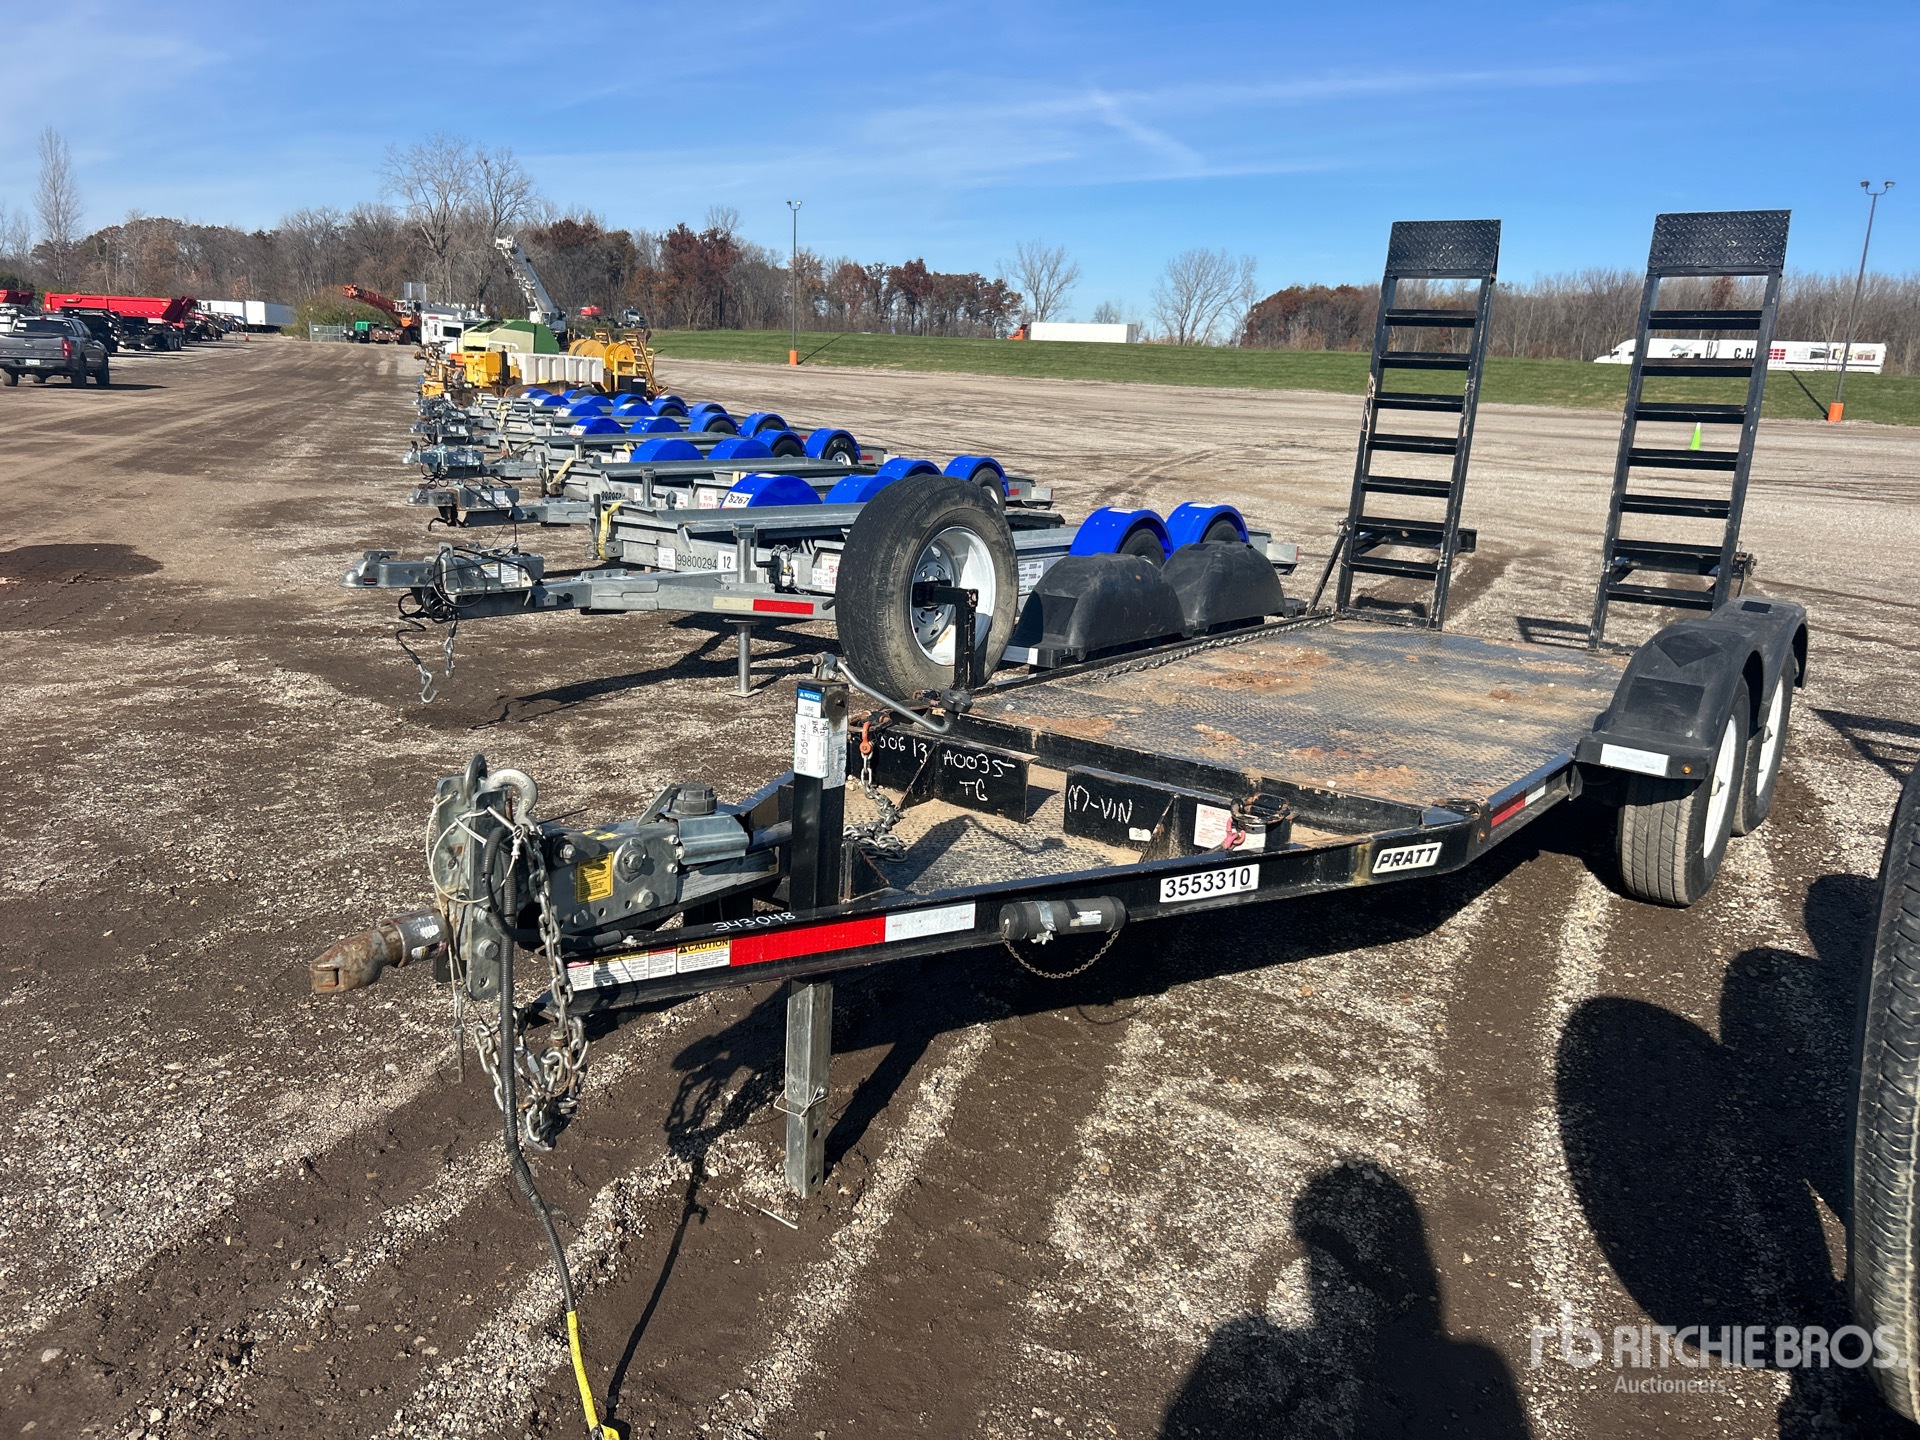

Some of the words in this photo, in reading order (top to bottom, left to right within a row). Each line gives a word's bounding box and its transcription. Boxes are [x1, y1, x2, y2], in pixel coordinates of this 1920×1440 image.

[677, 554, 717, 570] 99800294
[723, 556, 731, 569] 12
[804, 692, 820, 701] NOTICE
[943, 749, 1016, 778] A0035
[1376, 846, 1438, 869] PRATT
[1164, 867, 1251, 898] 3553310
[712, 911, 796, 932] 343048
[688, 937, 729, 952] CAUTION
